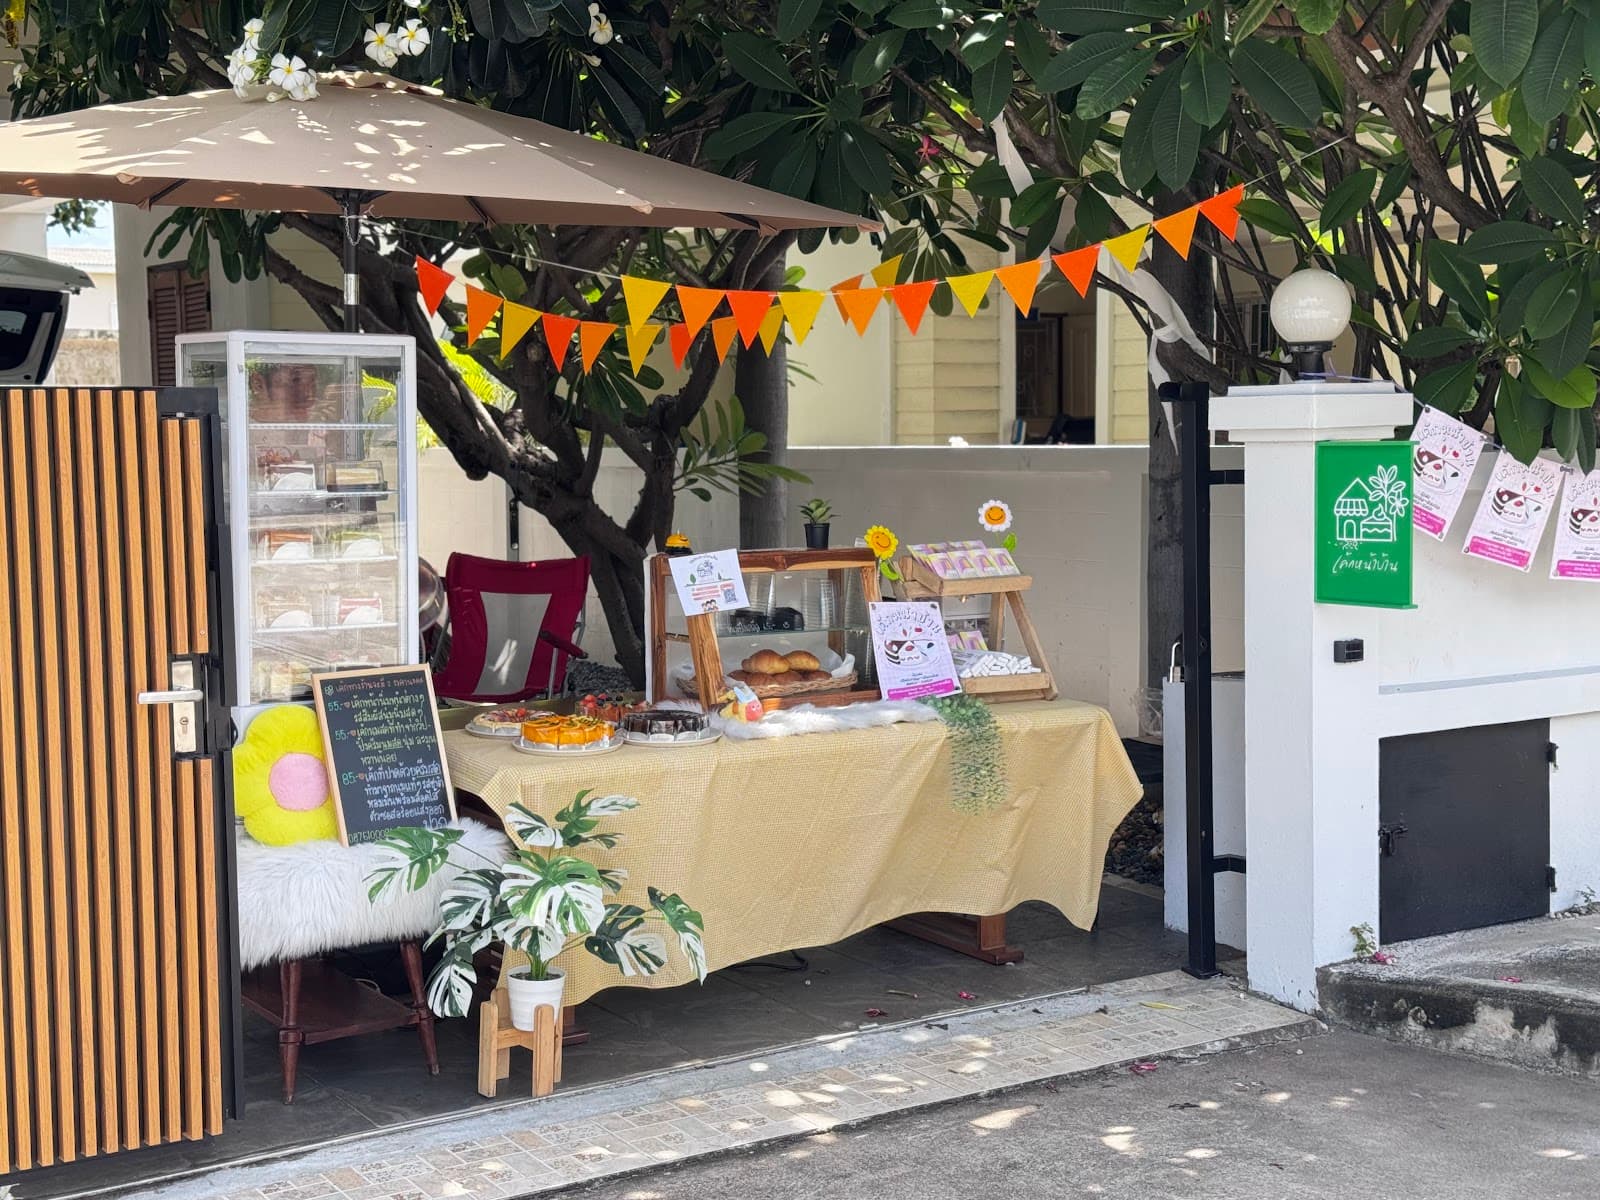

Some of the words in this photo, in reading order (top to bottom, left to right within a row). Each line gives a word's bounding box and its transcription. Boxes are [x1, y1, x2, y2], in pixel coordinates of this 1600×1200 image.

[1332, 552, 1399, 574] เค้กหน้าบ้าน
